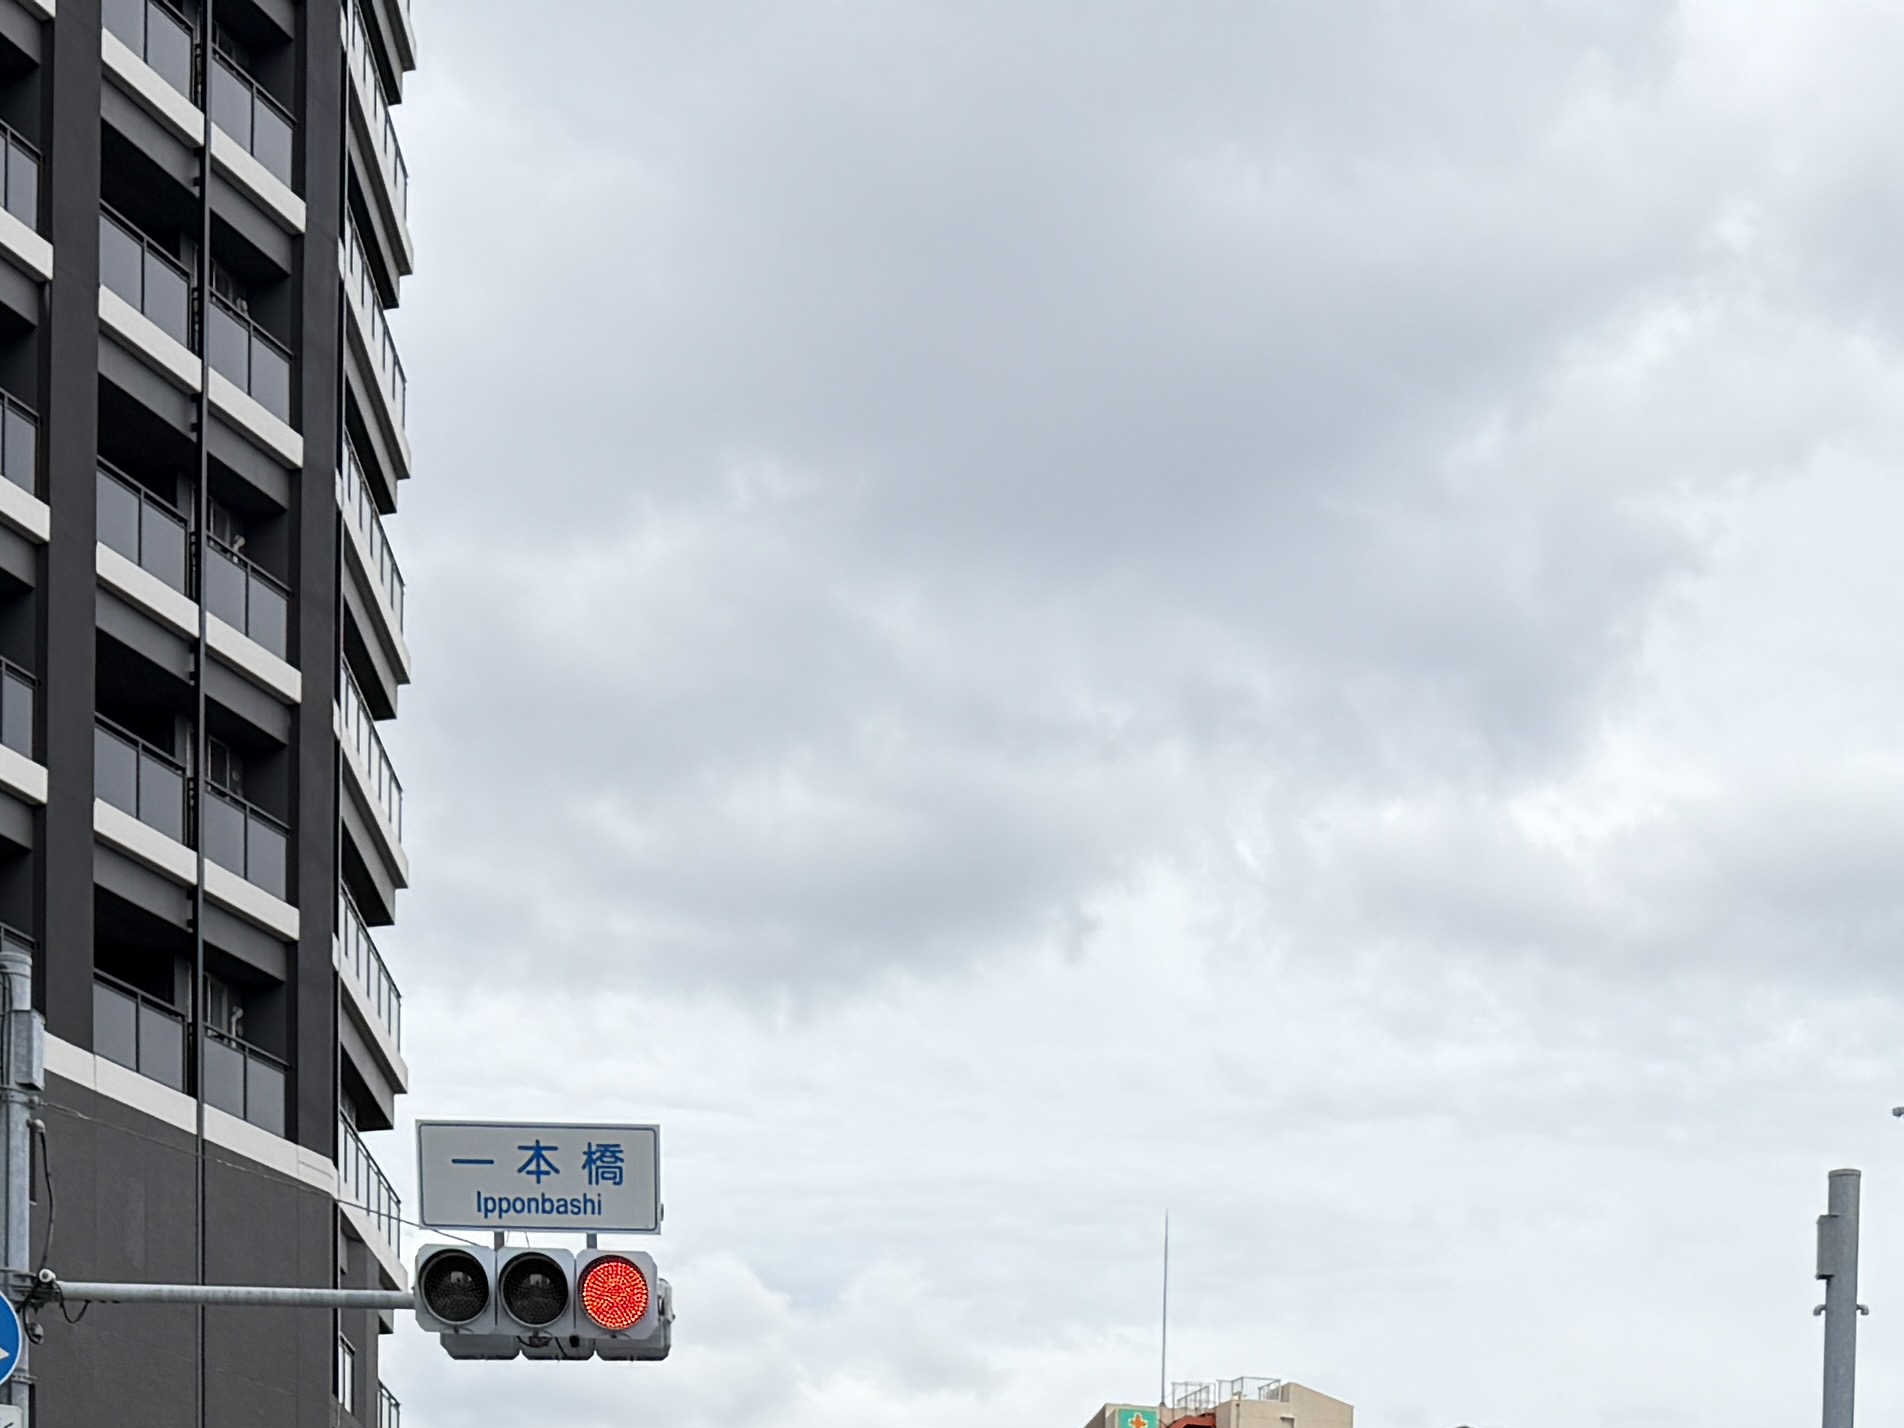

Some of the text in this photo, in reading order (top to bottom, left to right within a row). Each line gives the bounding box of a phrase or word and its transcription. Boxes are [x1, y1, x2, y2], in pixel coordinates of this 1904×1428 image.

[451, 1138, 626, 1187] 一本橋
[476, 1190, 603, 1220] Ipponbashi
